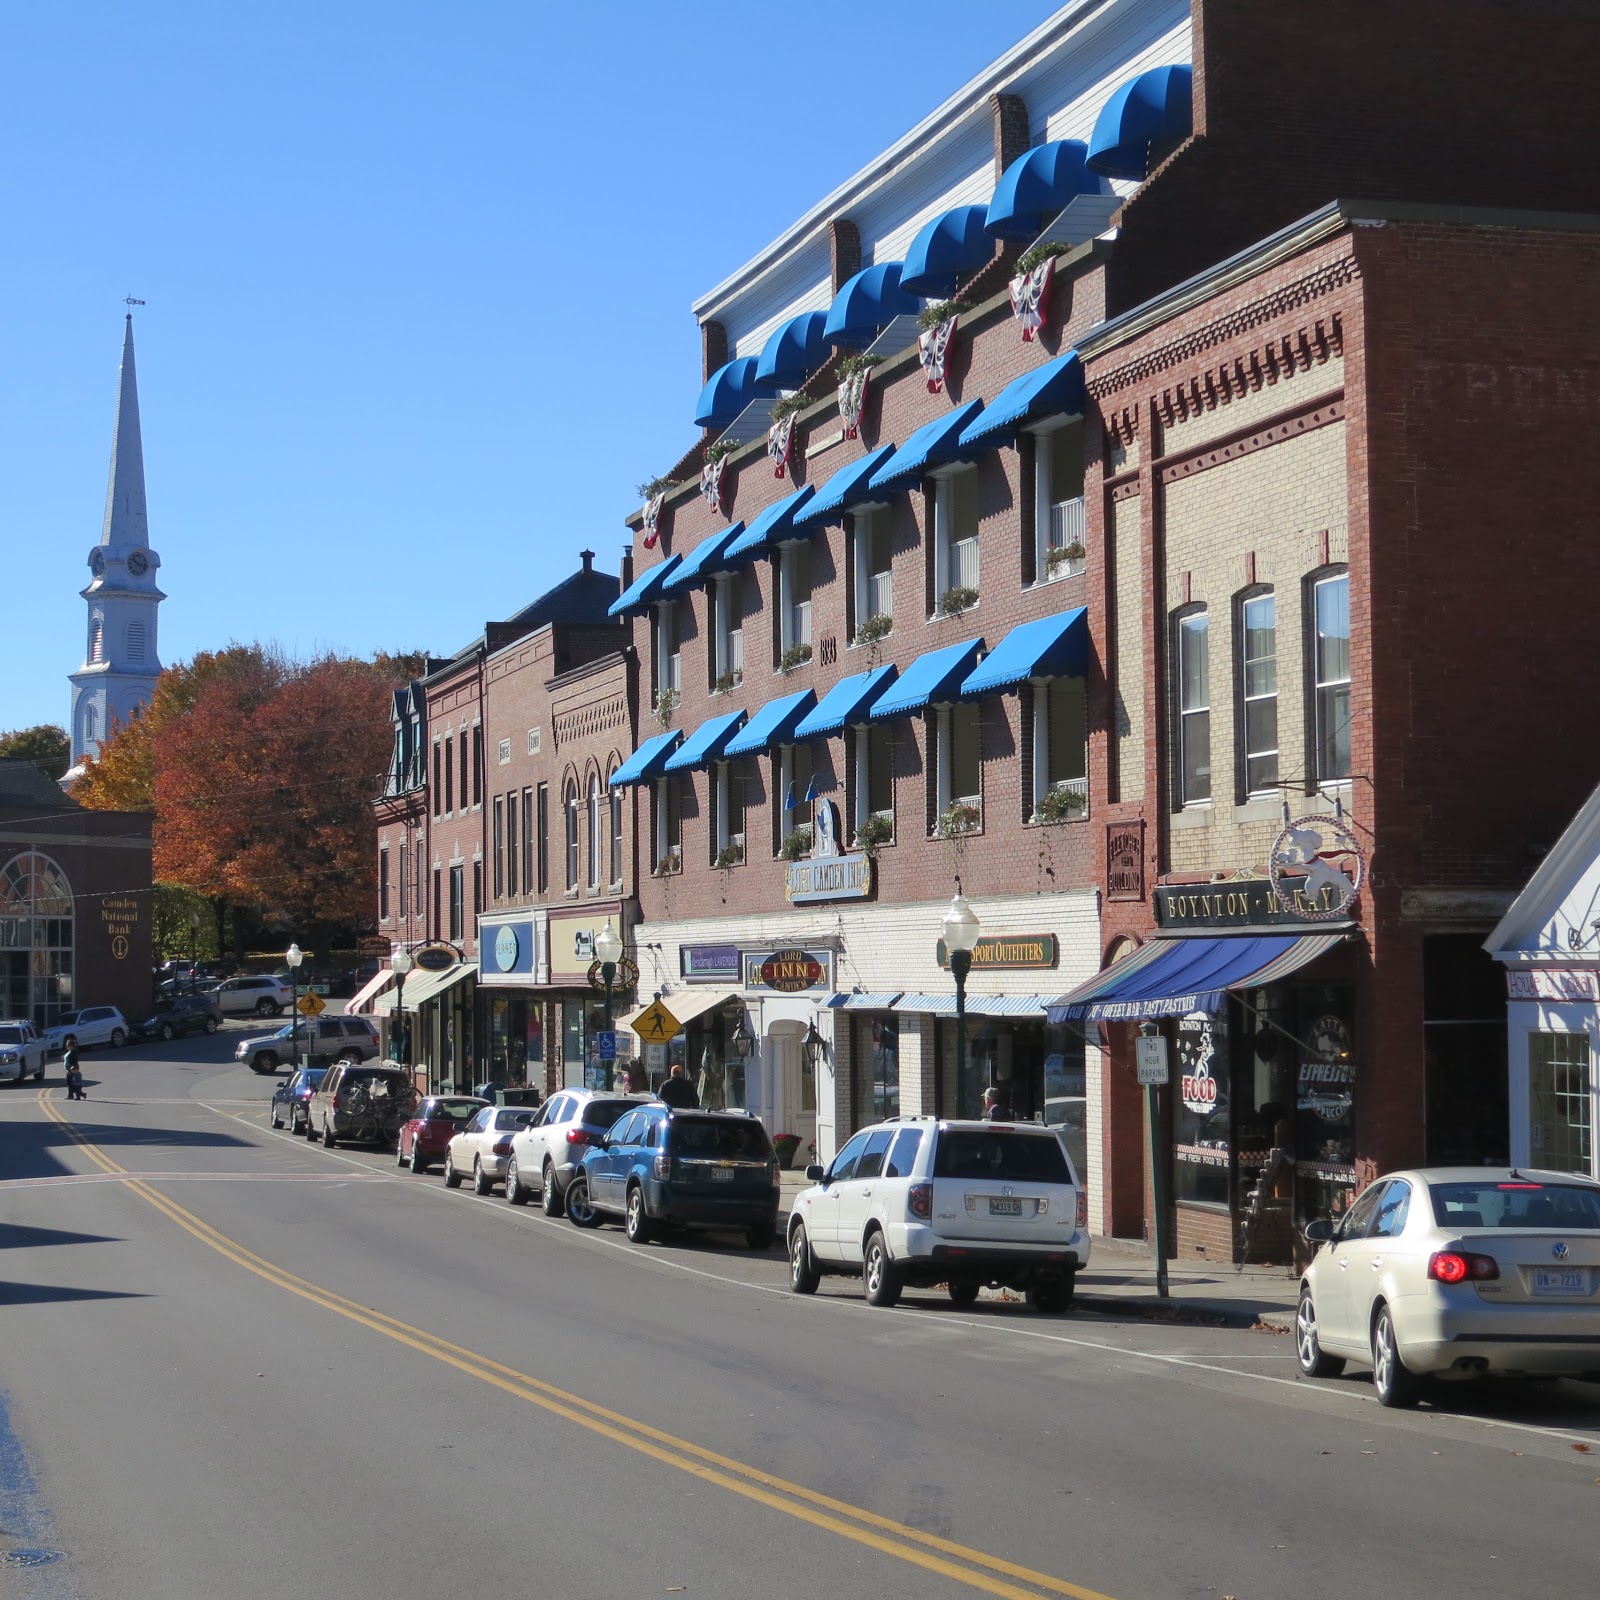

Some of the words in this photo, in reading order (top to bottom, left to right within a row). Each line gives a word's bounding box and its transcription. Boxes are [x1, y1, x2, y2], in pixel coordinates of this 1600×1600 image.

[820, 636, 837, 667] 1893
[814, 862, 845, 892] CAMDEN
[847, 860, 863, 889] INN
[1109, 872, 1140, 891] BUILDING
[101, 898, 138, 908] Camden
[1167, 893, 1250, 918] BOYNTON
[101, 910, 138, 921] National
[108, 924, 131, 934] Bank
[780, 951, 802, 961] LORD
[971, 944, 995, 962] SPORT
[995, 941, 1044, 961] OUTFITTERS
[714, 956, 738, 967] LAVENDER
[772, 962, 810, 978] INN
[593, 983, 625, 993] TRAING
[774, 979, 808, 992] CAMDEN
[1508, 973, 1541, 997] House
[1560, 973, 1597, 997] Logan
[1101, 1003, 1126, 1018] COFFEE
[1125, 1001, 1141, 1017] BAR
[1142, 1000, 1164, 1015] TASTY
[1162, 996, 1197, 1013] PASTRIES
[1179, 1020, 1202, 1031] BOYNTON
[1314, 1019, 1346, 1038] LATTE
[1146, 1043, 1158, 1052] TWO
[1144, 1056, 1160, 1065] HOUR
[1140, 1069, 1165, 1078] PARKING
[1183, 1075, 1217, 1103] FOOD
[1203, 1156, 1215, 1165] FOOD
[1215, 1158, 1222, 1166] TO
[1537, 1274, 1549, 1286] DN
[1560, 1274, 1582, 1287] 7219
